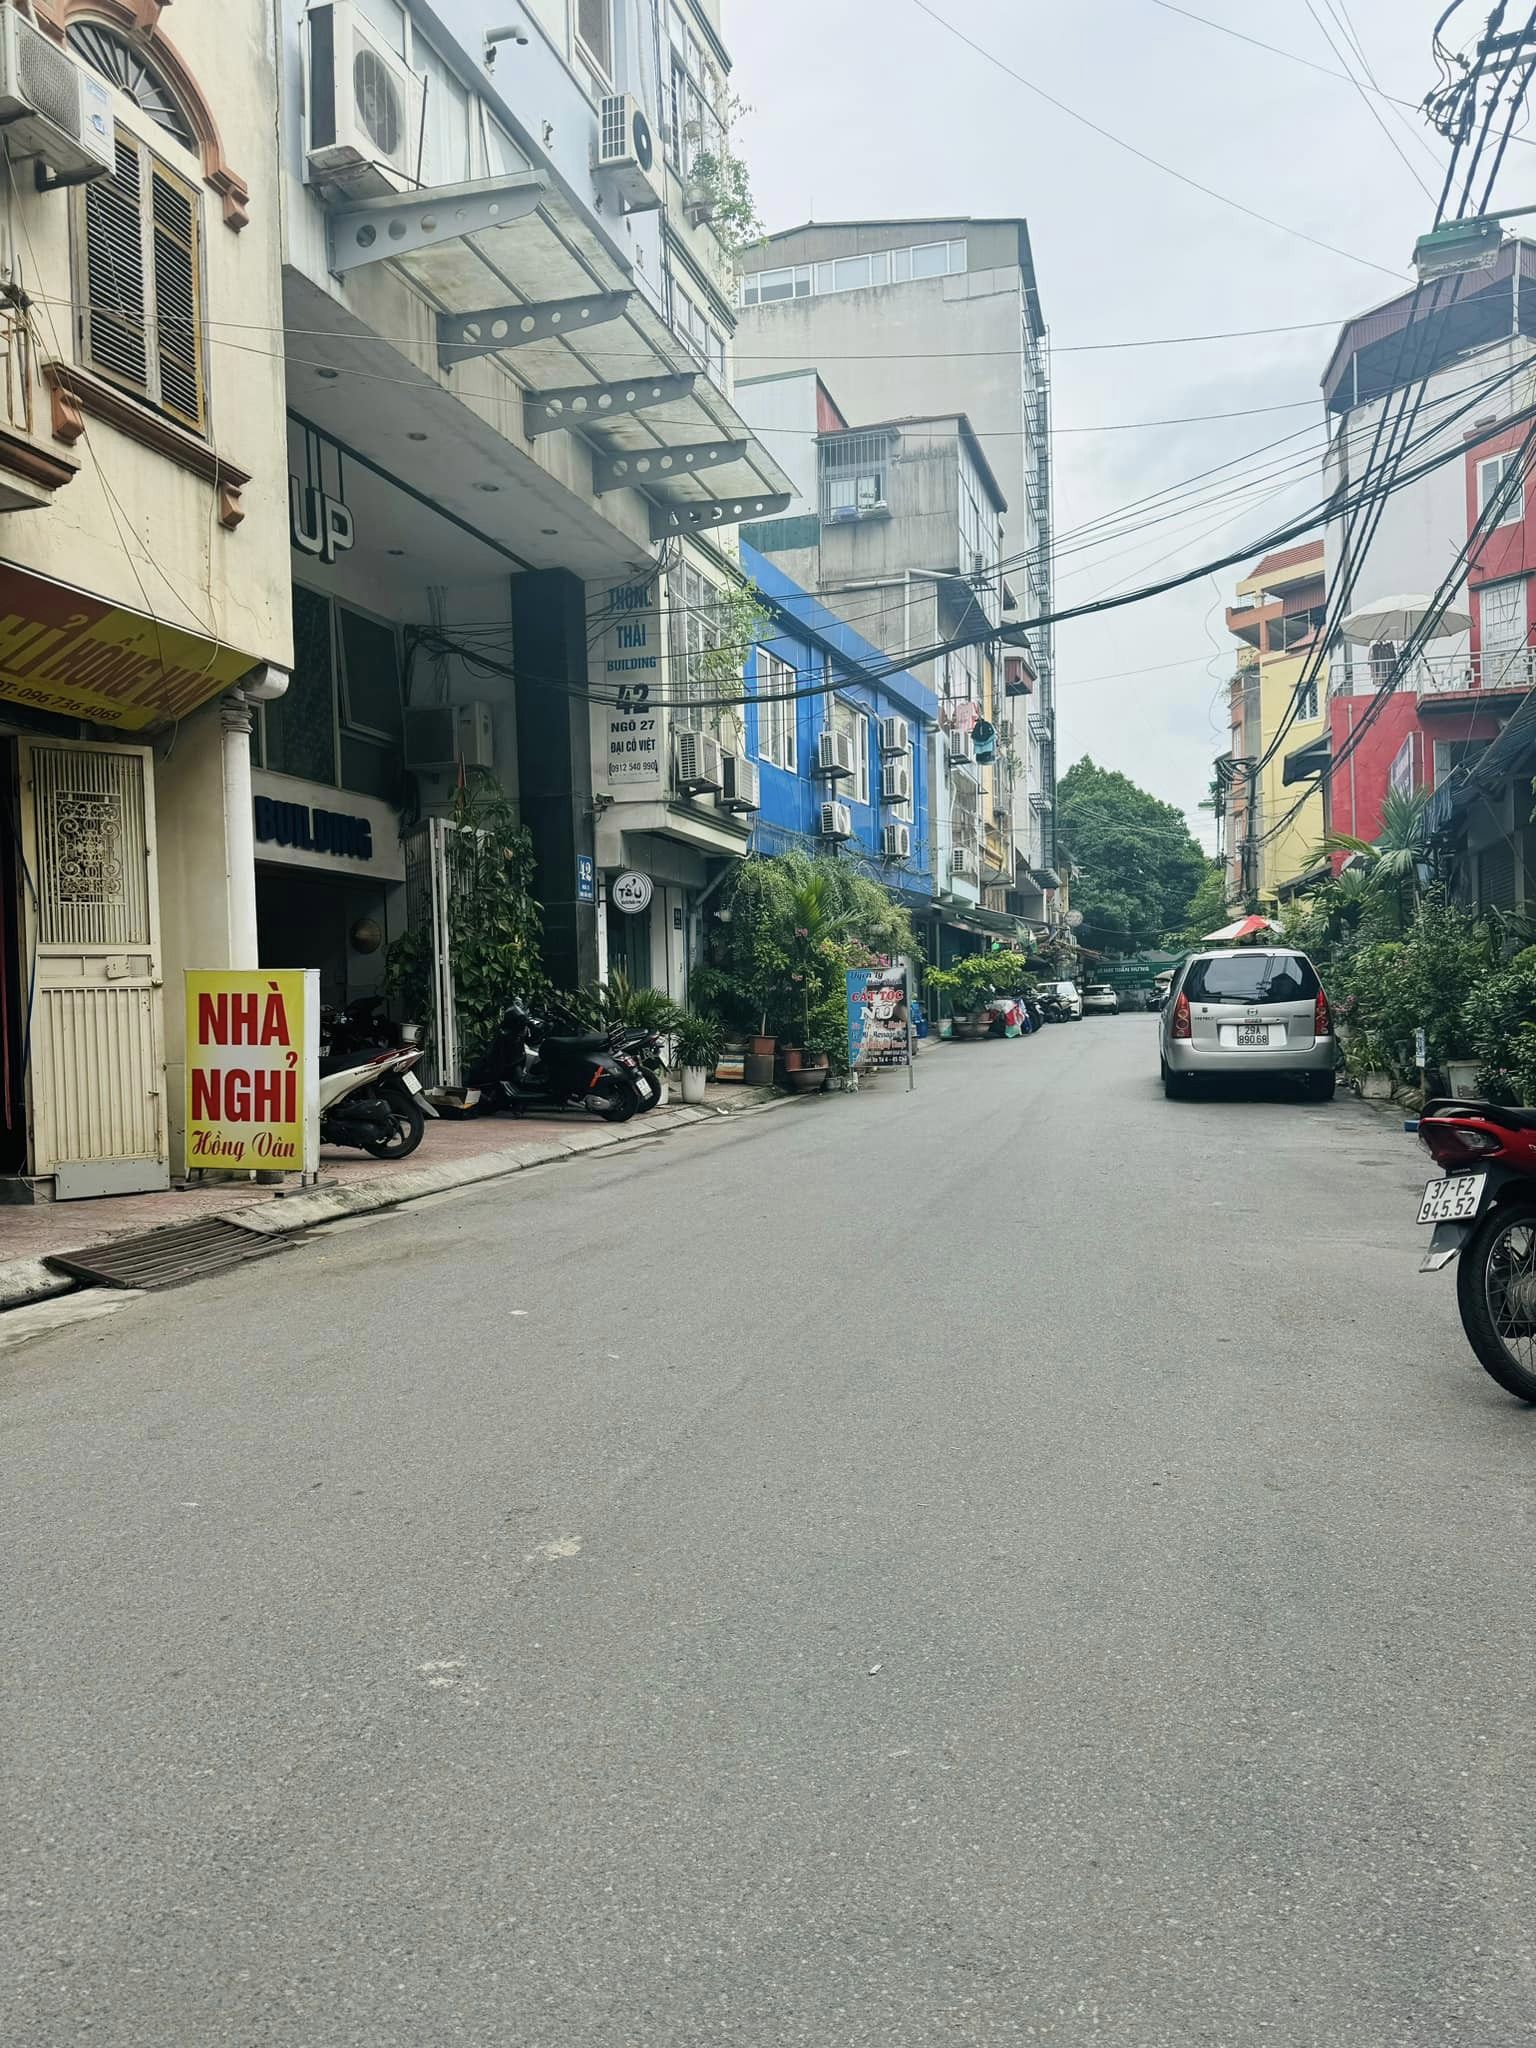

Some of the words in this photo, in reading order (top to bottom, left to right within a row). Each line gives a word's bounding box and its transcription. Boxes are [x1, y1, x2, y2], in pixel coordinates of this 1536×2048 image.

[616, 619, 646, 648] THÁI
[607, 656, 657, 672] BUILDING
[17, 688, 53, 703] 096
[51, 696, 85, 711] 736
[83, 704, 123, 721] 4069
[616, 683, 649, 715] 42
[640, 720, 655, 730] 27
[611, 741, 624, 755] ĐẠI
[639, 736, 656, 753] VIỆT
[629, 762, 641, 771] 540
[199, 981, 290, 1046] NHÀ
[1245, 1025, 1261, 1035] 29A
[192, 1051, 298, 1123] NGHỈ
[192, 1130, 246, 1161] Hồng
[252, 1131, 296, 1158] Vân
[1431, 1177, 1476, 1200] 37-F2
[1421, 1197, 1475, 1220] 945.52
